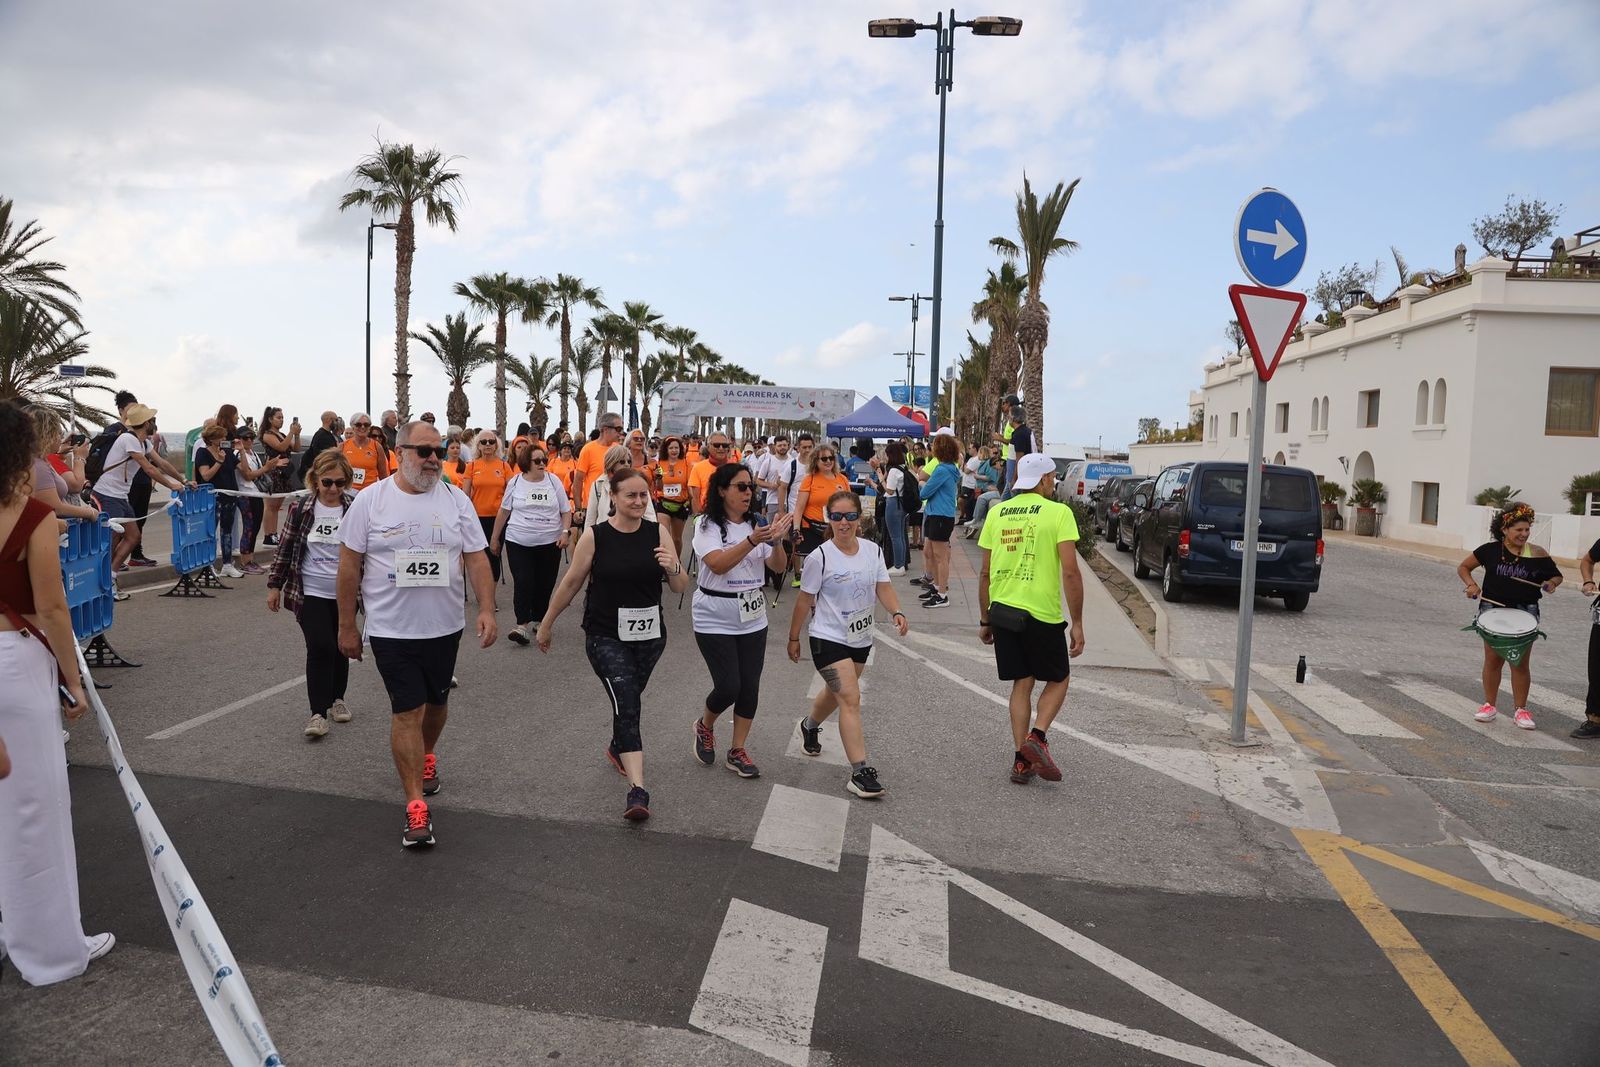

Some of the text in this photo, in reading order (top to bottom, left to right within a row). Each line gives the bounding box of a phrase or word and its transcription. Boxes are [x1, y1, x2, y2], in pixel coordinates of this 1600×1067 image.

[723, 389, 792, 399] 3A CARRERA 5K
[531, 493, 548, 501] 981
[1000, 504, 1042, 517] CARRERA 5K
[1258, 543, 1273, 551] HNR
[405, 561, 440, 576] 452
[627, 618, 654, 632] 737
[849, 614, 873, 633] 1030
